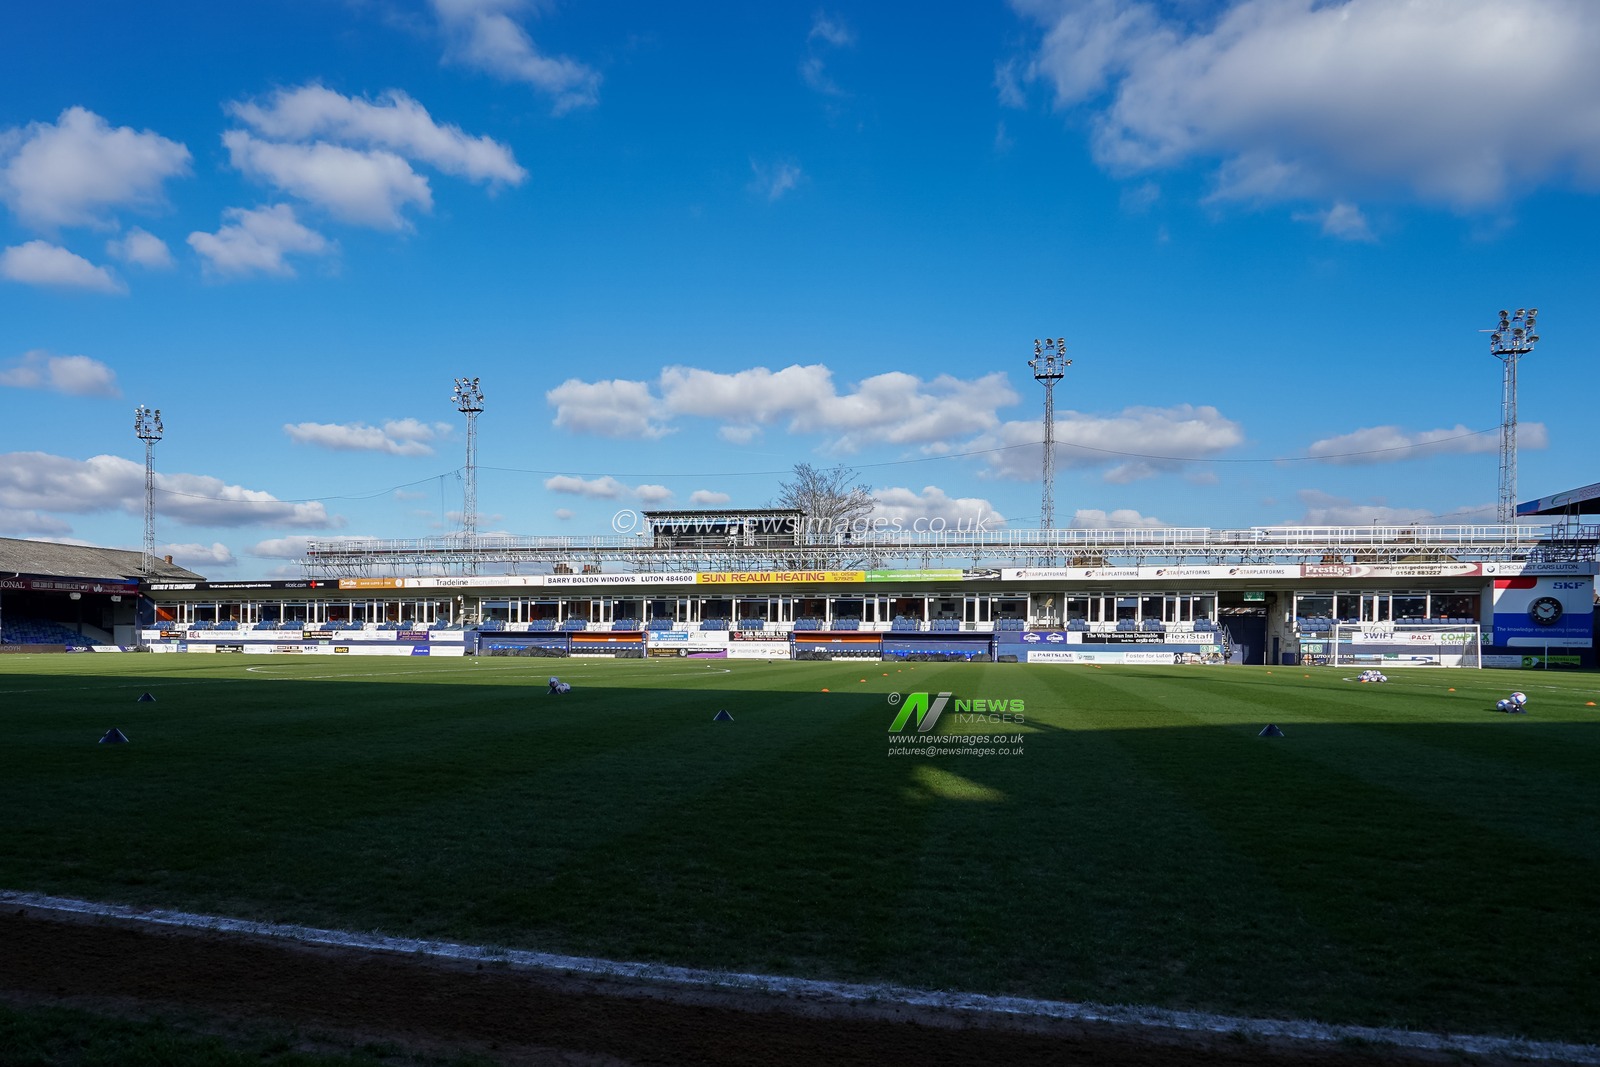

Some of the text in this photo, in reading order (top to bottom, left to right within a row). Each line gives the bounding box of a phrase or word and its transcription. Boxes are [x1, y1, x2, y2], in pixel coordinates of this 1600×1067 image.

[1306, 565, 1350, 575] Prestige
[702, 572, 825, 582] SUN REALM HEATING
[1553, 582, 1585, 590] SKF
[1441, 633, 1490, 641] COMPLX
